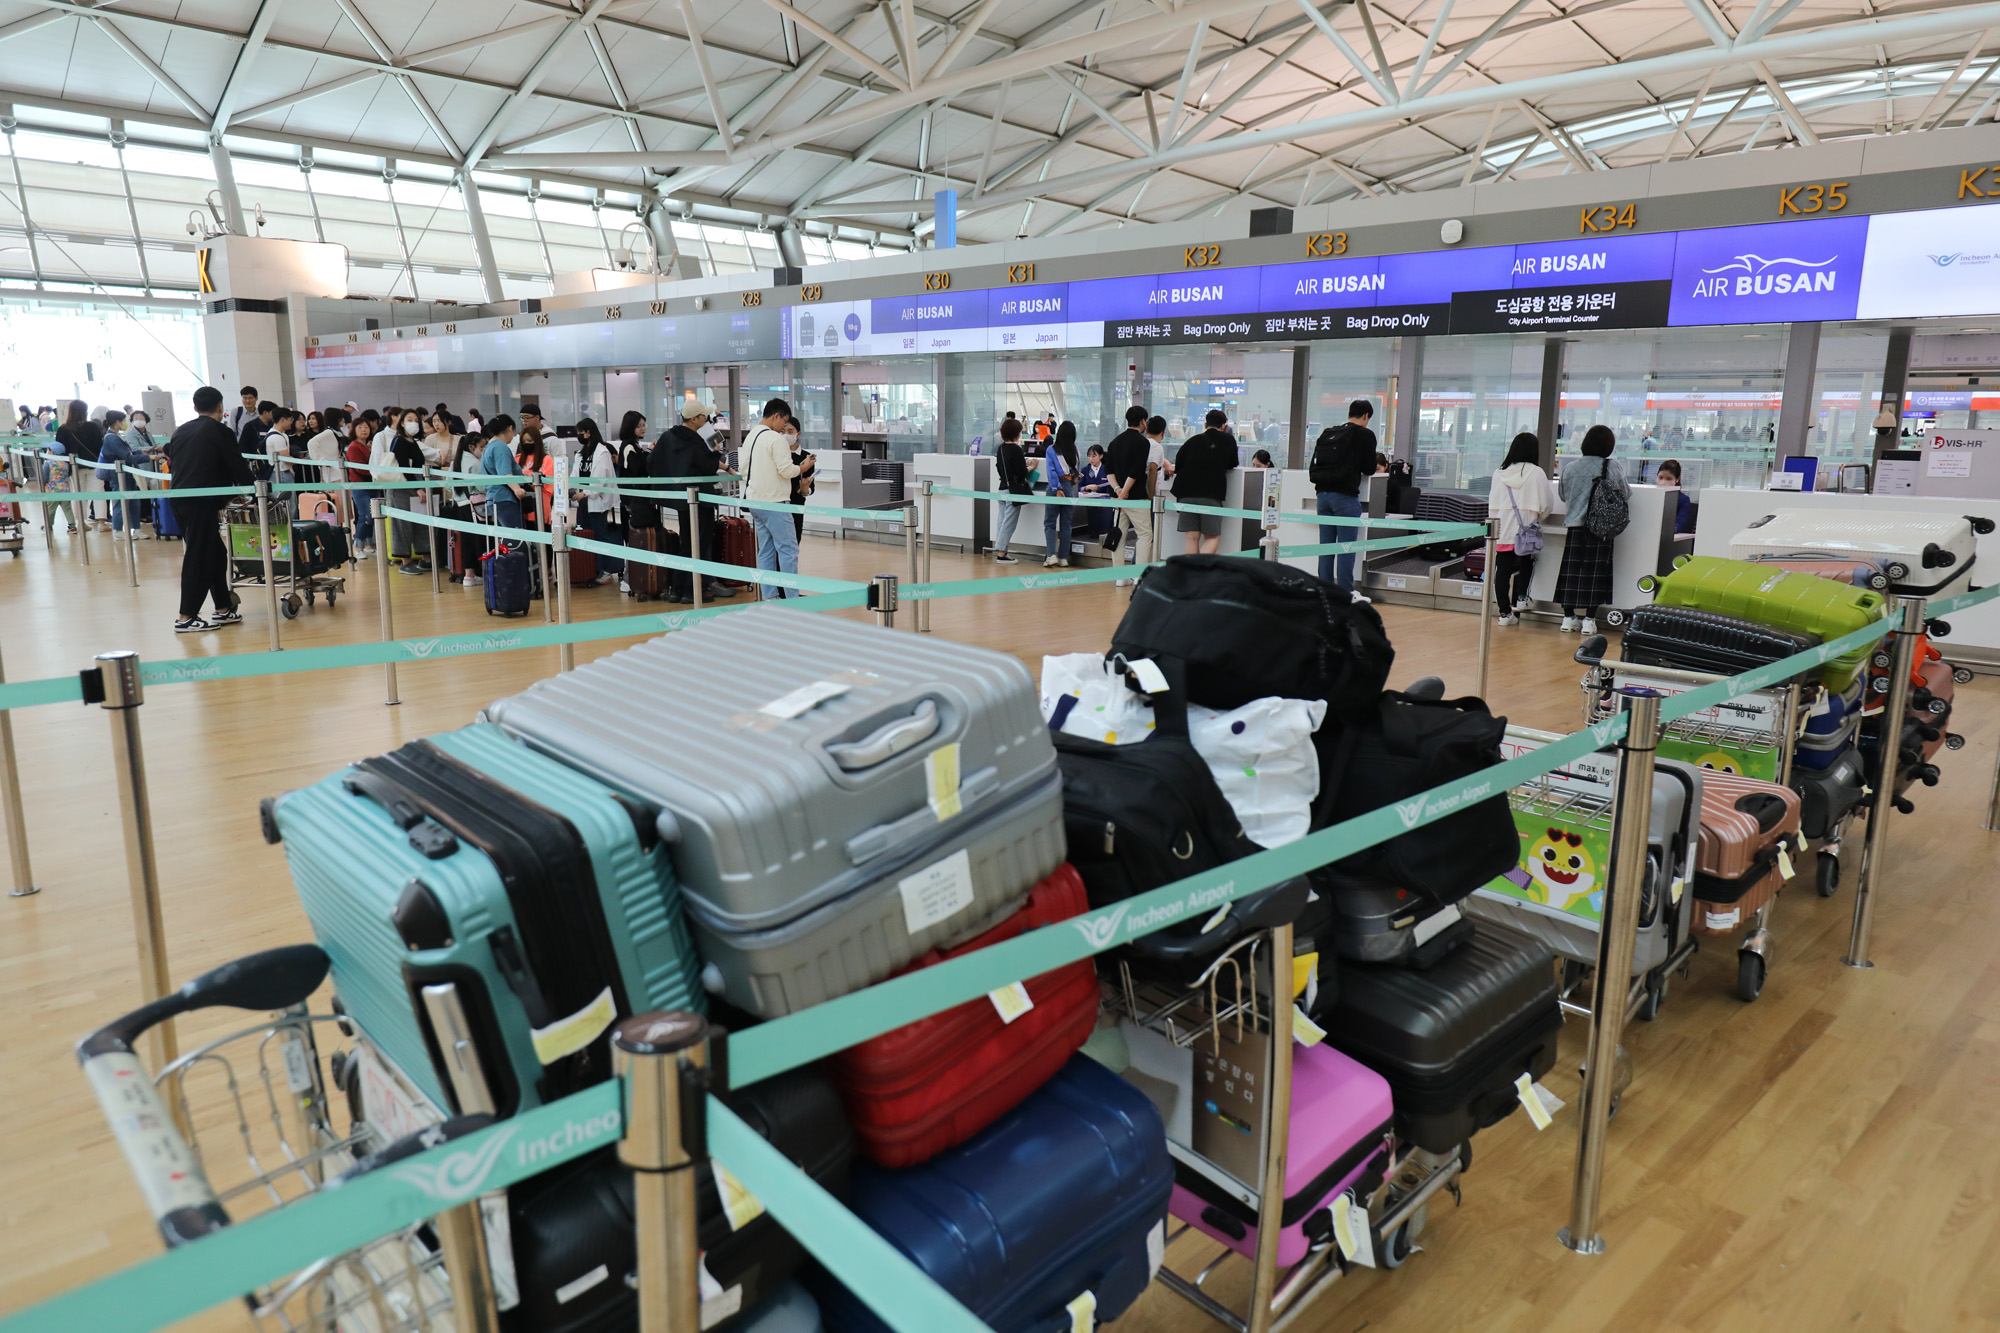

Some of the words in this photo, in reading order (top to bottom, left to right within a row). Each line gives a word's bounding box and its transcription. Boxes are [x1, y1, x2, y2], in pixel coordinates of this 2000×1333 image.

[1958, 166, 2000, 199] K3
[1778, 182, 1849, 215] K35
[1580, 203, 1637, 233] K34
[1306, 232, 1348, 257] K33
[1184, 245, 1221, 267] K32
[1511, 258, 1536, 276] AIR
[1540, 253, 1607, 273] BUSAN
[198, 247, 214, 293] K
[1008, 264, 1035, 283] K31
[925, 272, 950, 290] K30
[1295, 279, 1318, 295] AIR
[1322, 274, 1386, 293] BUSAN
[1692, 278, 1728, 298] AIR
[1735, 271, 1836, 296] BUSAN
[741, 292, 761, 307] K28
[801, 285, 821, 301] K29
[1149, 290, 1168, 304] AIR
[1171, 286, 1223, 303] BUSAN
[650, 301, 666, 315] K27
[1001, 301, 1017, 315] AIR
[1019, 298, 1061, 313] BUSAN
[1495, 296, 1545, 314] 도심공항
[1547, 294, 1573, 312] 전용
[1576, 292, 1616, 311] 카운터
[535, 314, 548, 326] K25
[605, 306, 620, 319] K26
[901, 307, 915, 321] AIR
[917, 305, 953, 320] BUSAN
[1508, 318, 1521, 326] City
[1522, 316, 1544, 325] Airport
[1545, 315, 1571, 324] Terminal
[1572, 314, 1600, 323] Counter
[501, 318, 513, 328] K24
[1184, 325, 1201, 337] Bag
[1204, 323, 1226, 336] Drop
[1228, 321, 1251, 335] Only
[1265, 318, 1285, 333] 짐만
[1288, 317, 1318, 332] 부치는
[1320, 316, 1331, 330] 곳
[1346, 316, 1369, 330] Bag
[1371, 315, 1399, 329] Drop
[1402, 313, 1430, 328] Only
[1002, 333, 1016, 345] 일본
[1035, 333, 1058, 343] Japan
[1117, 325, 1133, 339] 짐만
[1135, 325, 1161, 338] 부치는
[1163, 324, 1171, 337] 곳
[903, 338, 915, 349] 일본
[931, 338, 951, 348] Japan
[1037, 578, 1058, 587] Incheon
[1059, 576, 1078, 585] Airport
[912, 589, 935, 598] Airport
[440, 642, 482, 654] Incheon
[485, 637, 521, 649] Airport
[173, 666, 220, 679] Airport
[1747, 712, 1756, 720] kg
[1579, 763, 1598, 773] max.
[1602, 766, 1613, 775] lo
[1425, 794, 1460, 818] Incheon
[1461, 781, 1490, 802] Airport
[1127, 900, 1184, 933] Incheon
[1187, 880, 1234, 909] Airport
[518, 1109, 621, 1166] Incheo
